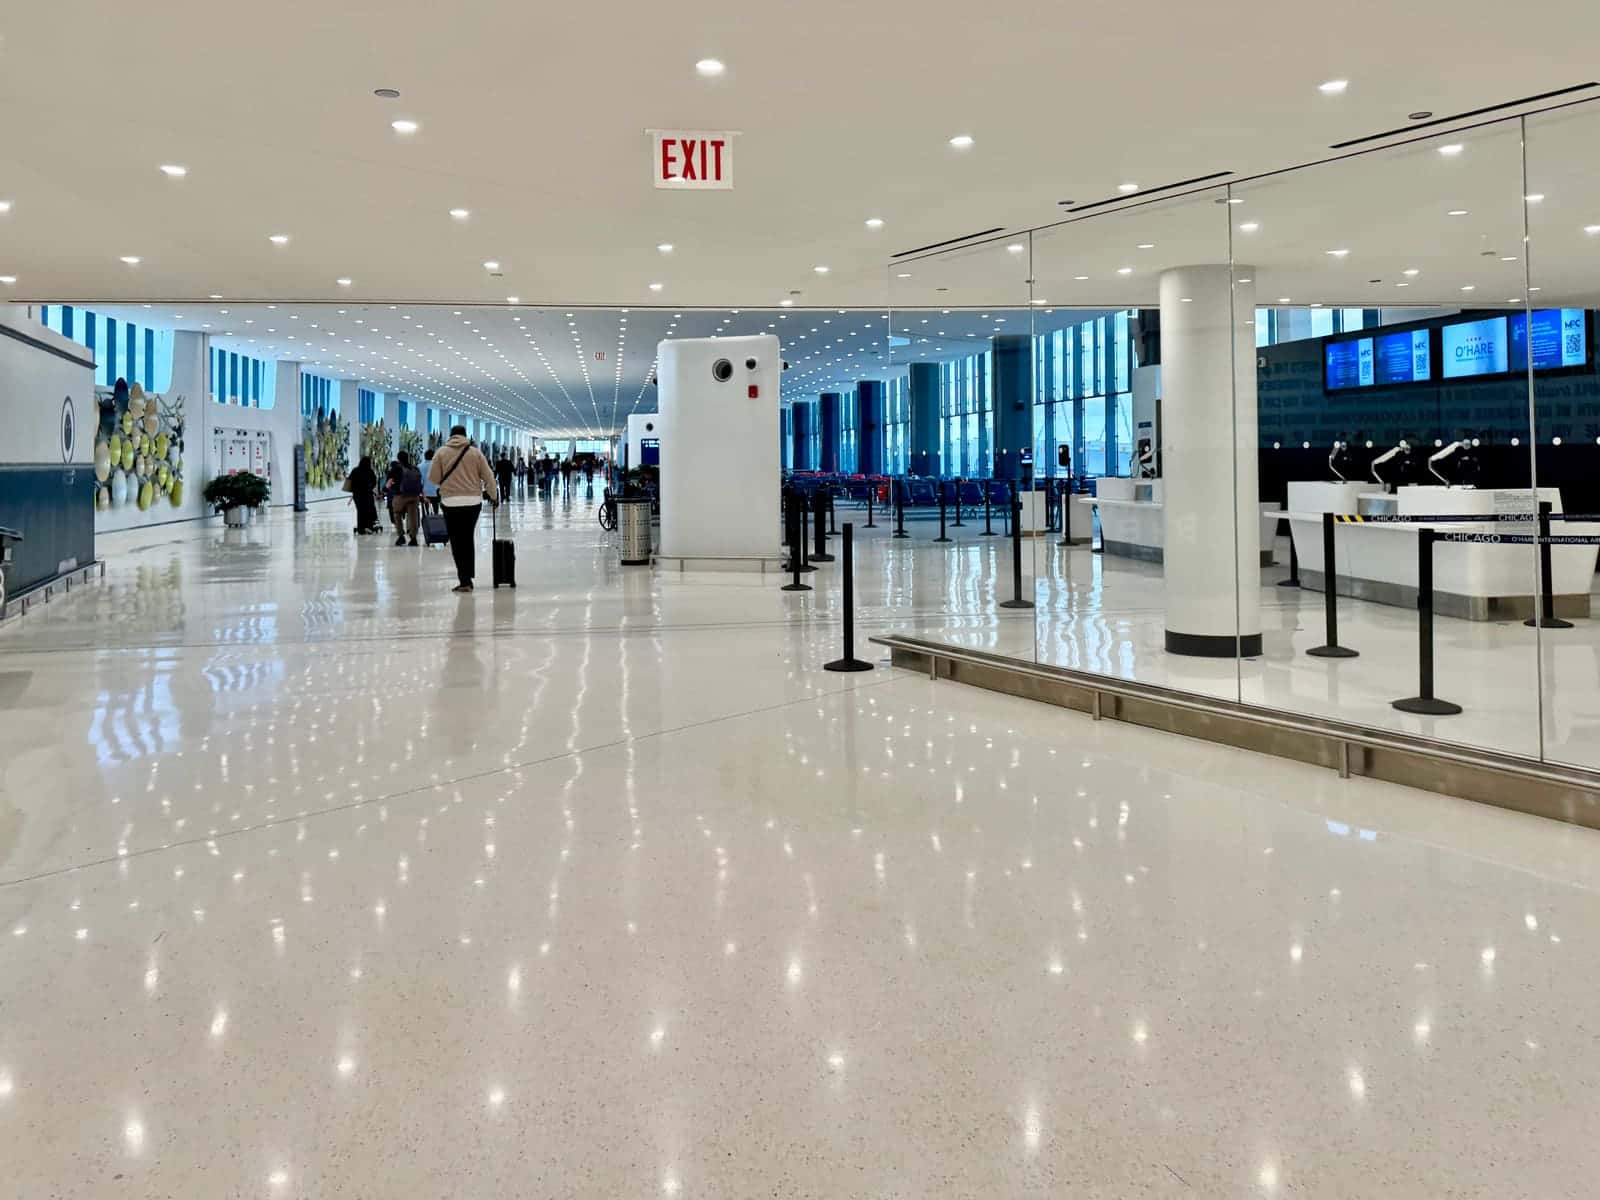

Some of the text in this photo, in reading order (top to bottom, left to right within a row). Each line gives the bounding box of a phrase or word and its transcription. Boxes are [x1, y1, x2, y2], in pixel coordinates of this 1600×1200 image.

[662, 139, 725, 181] EXIT
[1455, 342, 1495, 358] O'HARE
[1370, 515, 1412, 523] CHICAGO
[1498, 514, 1540, 522] CHICAG
[1445, 533, 1501, 543] CHICAGO
